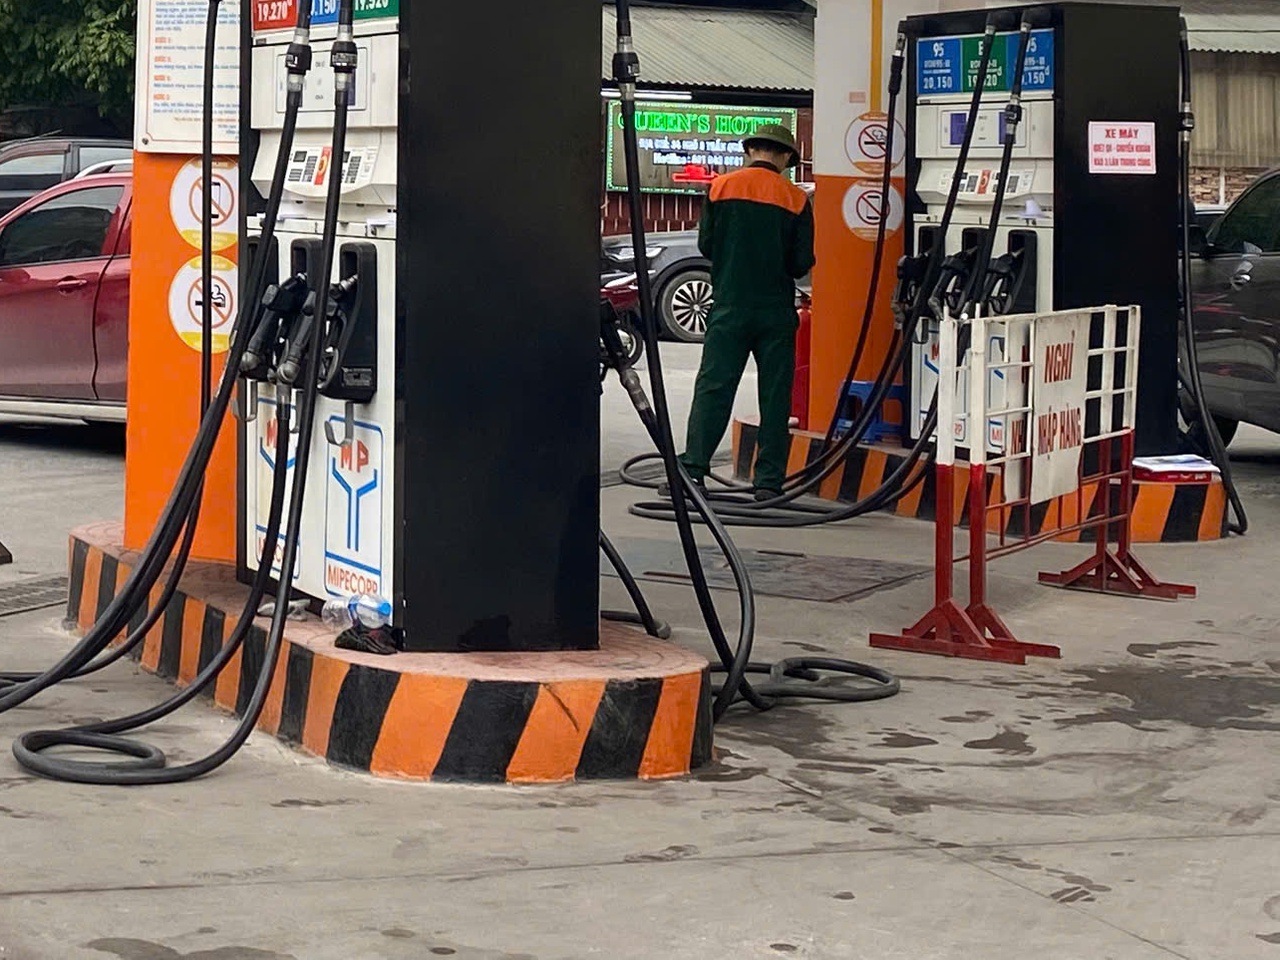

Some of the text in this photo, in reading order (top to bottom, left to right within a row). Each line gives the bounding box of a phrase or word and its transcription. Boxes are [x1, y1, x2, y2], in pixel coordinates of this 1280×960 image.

[932, 42, 945, 57] 95
[1025, 37, 1037, 53] 5
[715, 114, 782, 136] HOT
[1105, 127, 1139, 139] XE MÁY
[1043, 329, 1076, 384] NGHỈ
[1058, 402, 1082, 452] HÀNG
[340, 440, 369, 473] MP
